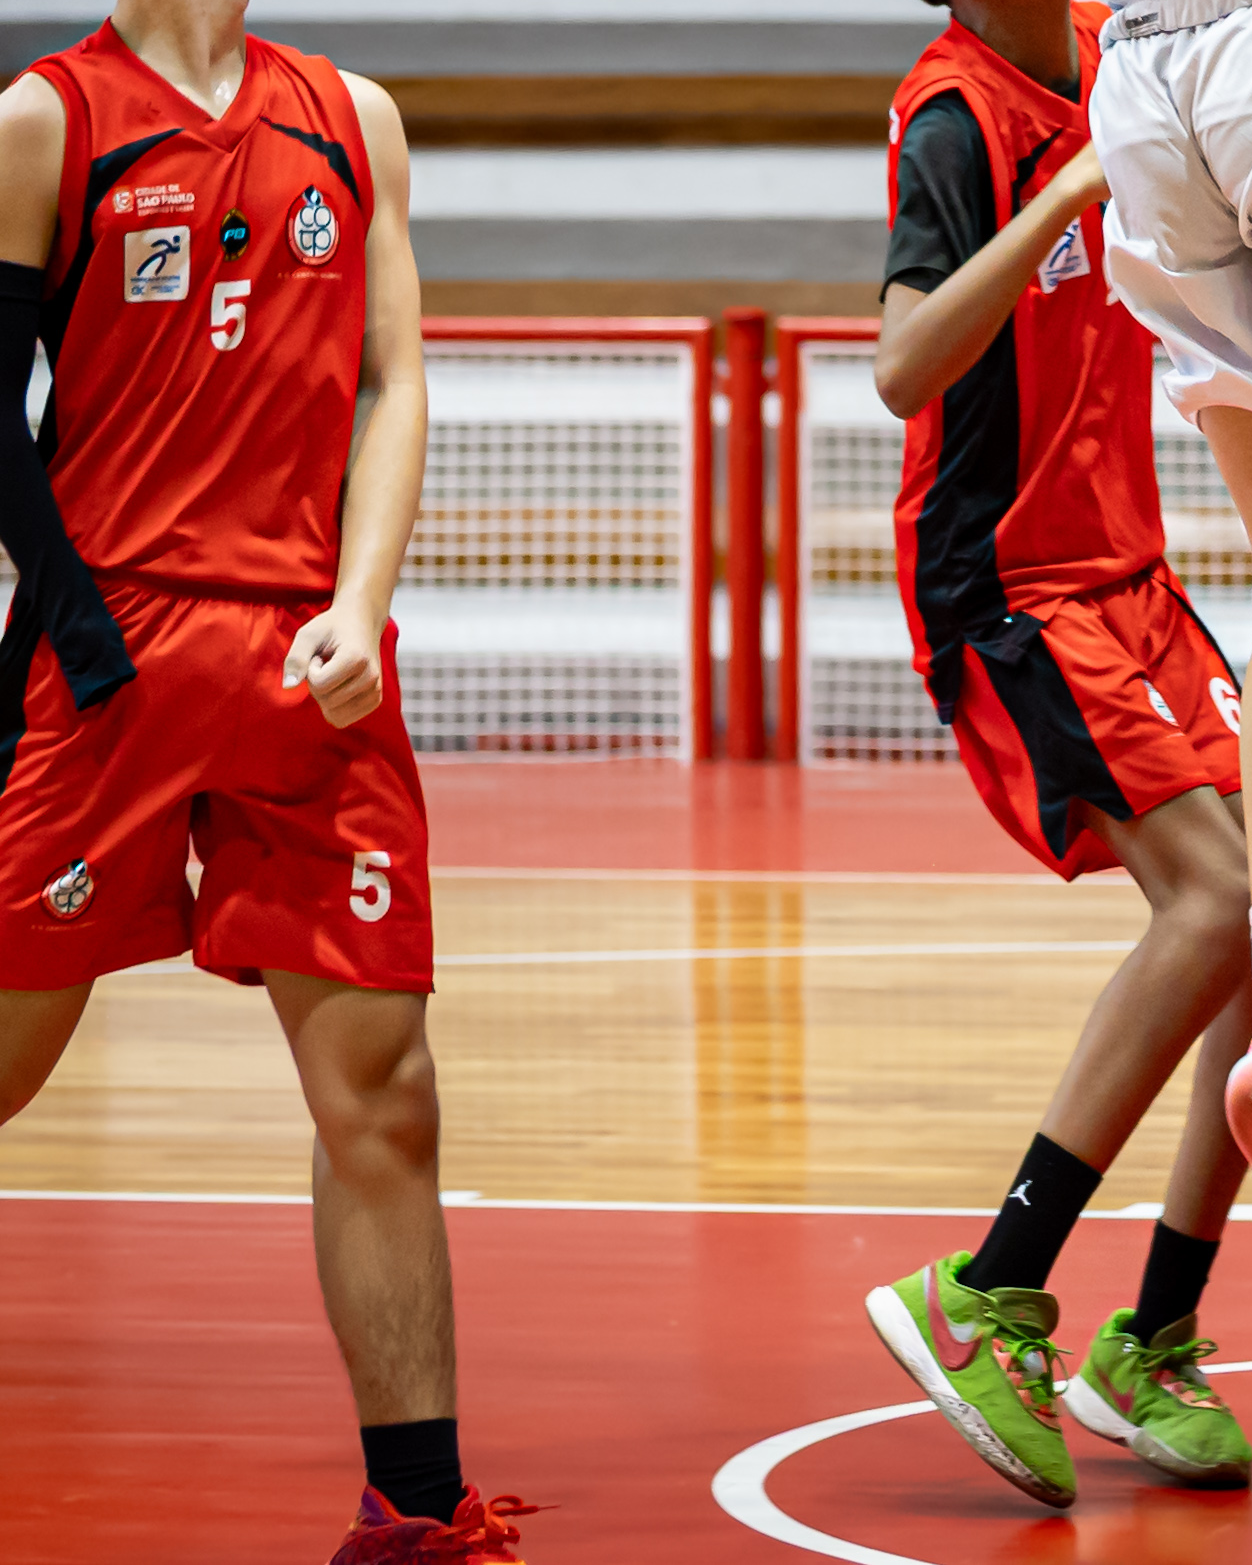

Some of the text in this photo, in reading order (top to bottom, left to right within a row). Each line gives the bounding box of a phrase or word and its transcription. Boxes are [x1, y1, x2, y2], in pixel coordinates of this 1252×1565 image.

[210, 279, 252, 352] 5
[1208, 677, 1241, 736] 6
[349, 850, 392, 923] 5
